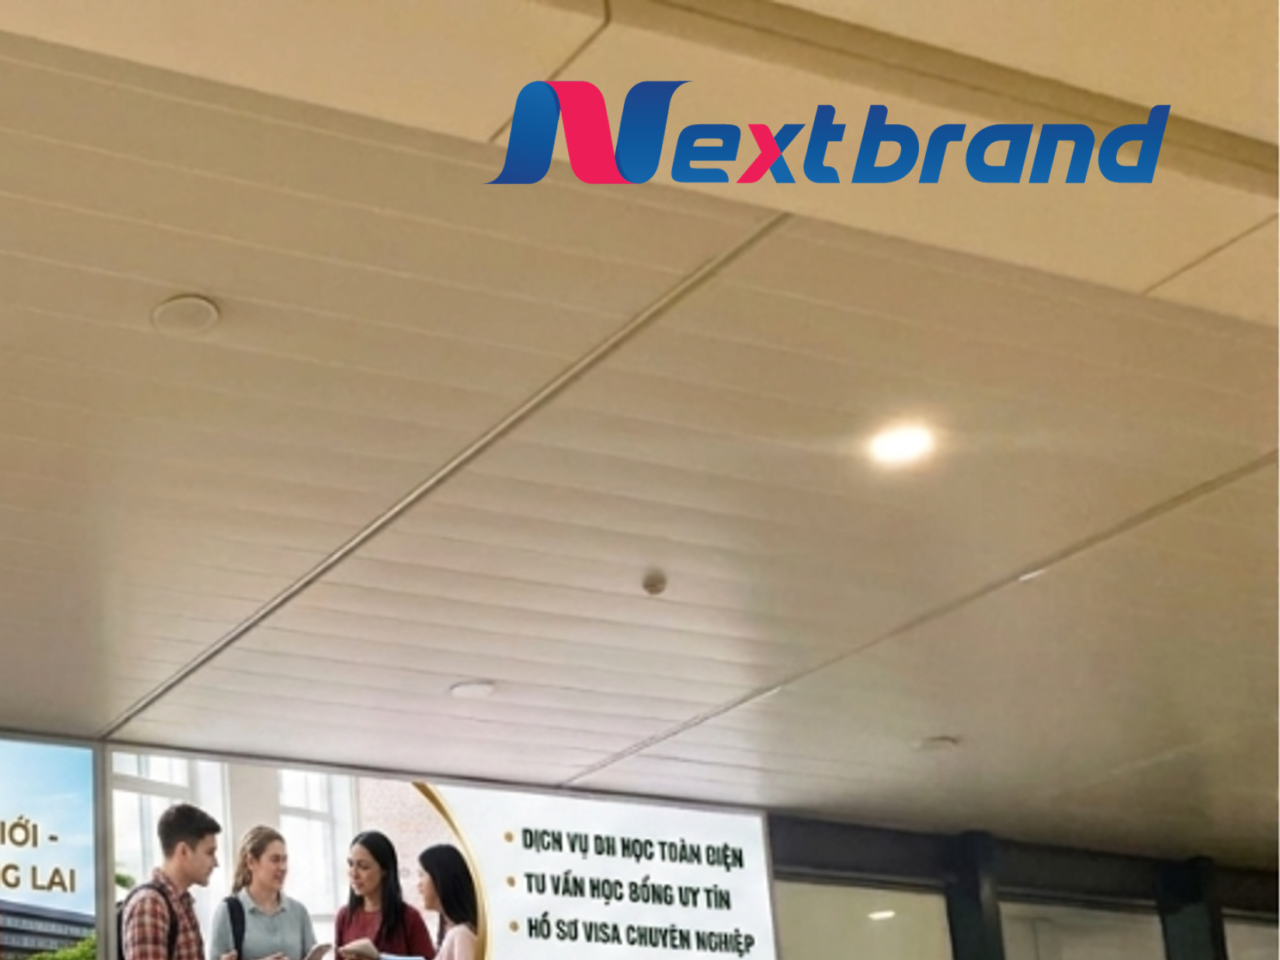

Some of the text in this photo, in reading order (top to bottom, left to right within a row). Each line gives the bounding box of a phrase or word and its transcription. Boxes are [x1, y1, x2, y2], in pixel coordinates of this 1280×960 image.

[32, 865, 75, 893] LAI
[678, 886, 700, 908] UY
[582, 922, 622, 946] VISA
